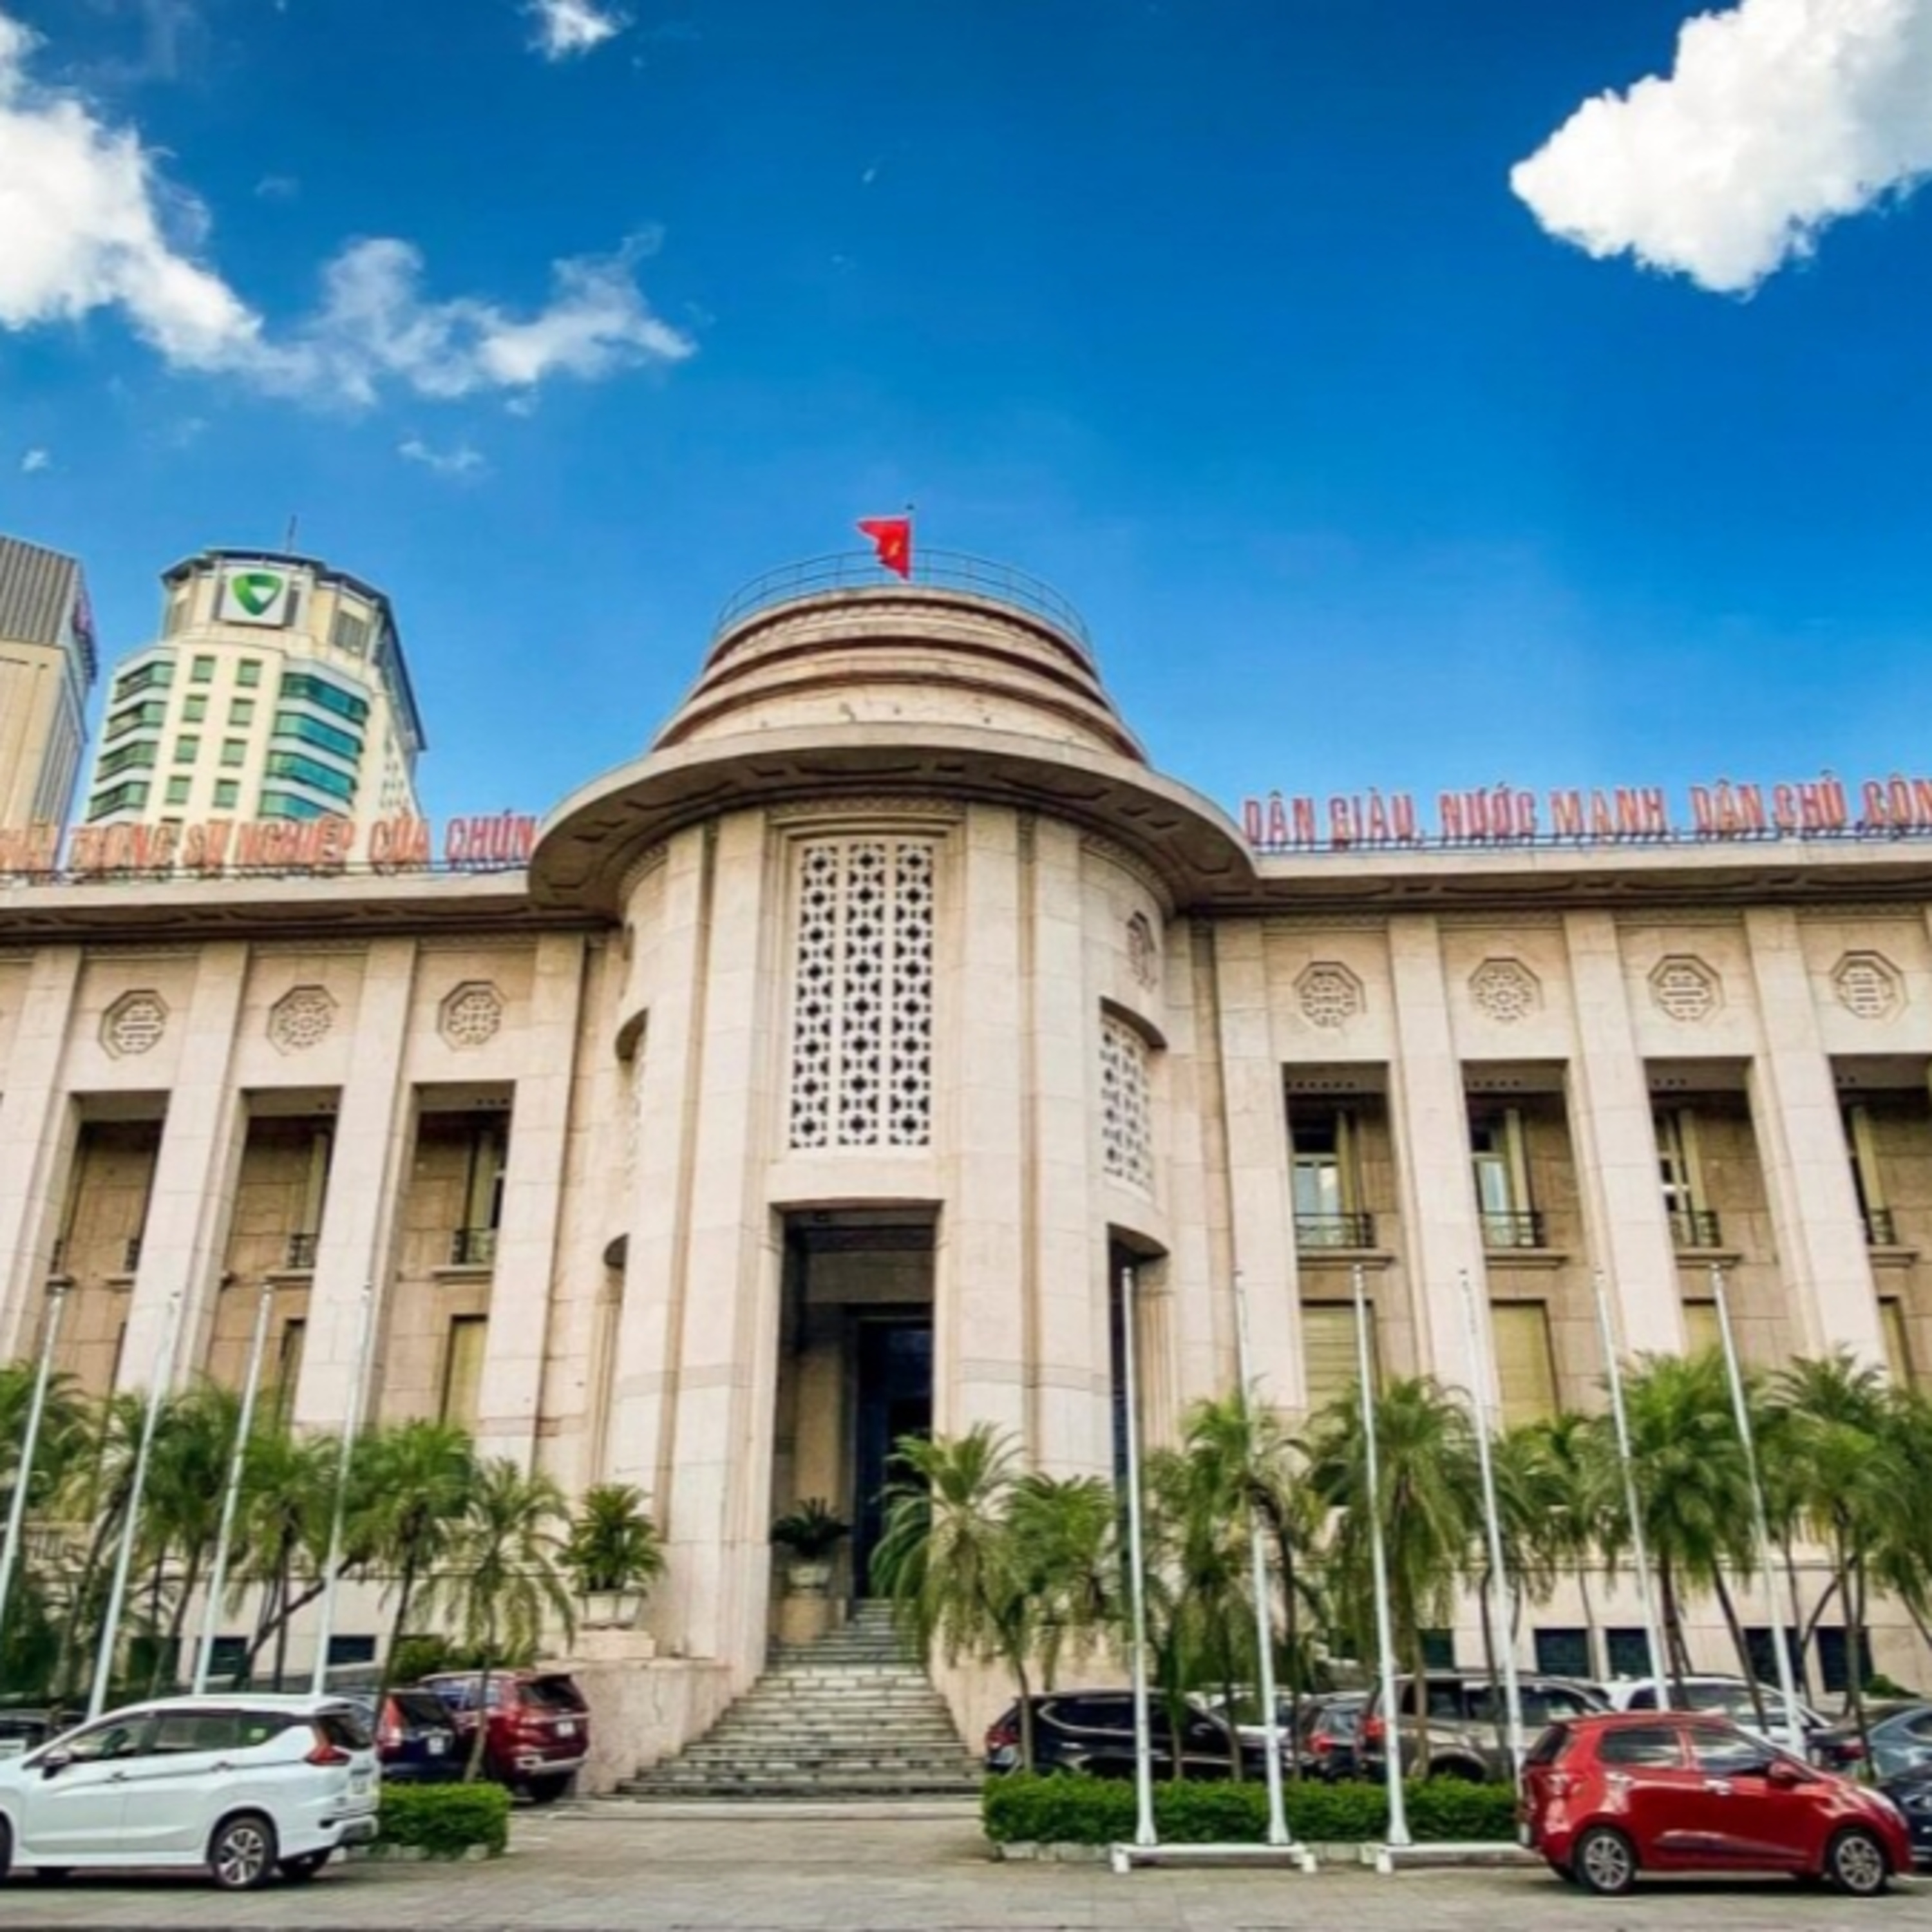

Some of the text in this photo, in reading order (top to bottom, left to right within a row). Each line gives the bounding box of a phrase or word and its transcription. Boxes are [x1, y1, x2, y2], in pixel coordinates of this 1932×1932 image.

[1244, 790, 1315, 845] DÂN
[1439, 781, 1537, 839] NƯỚC
[1690, 779, 1767, 837] DÂN
